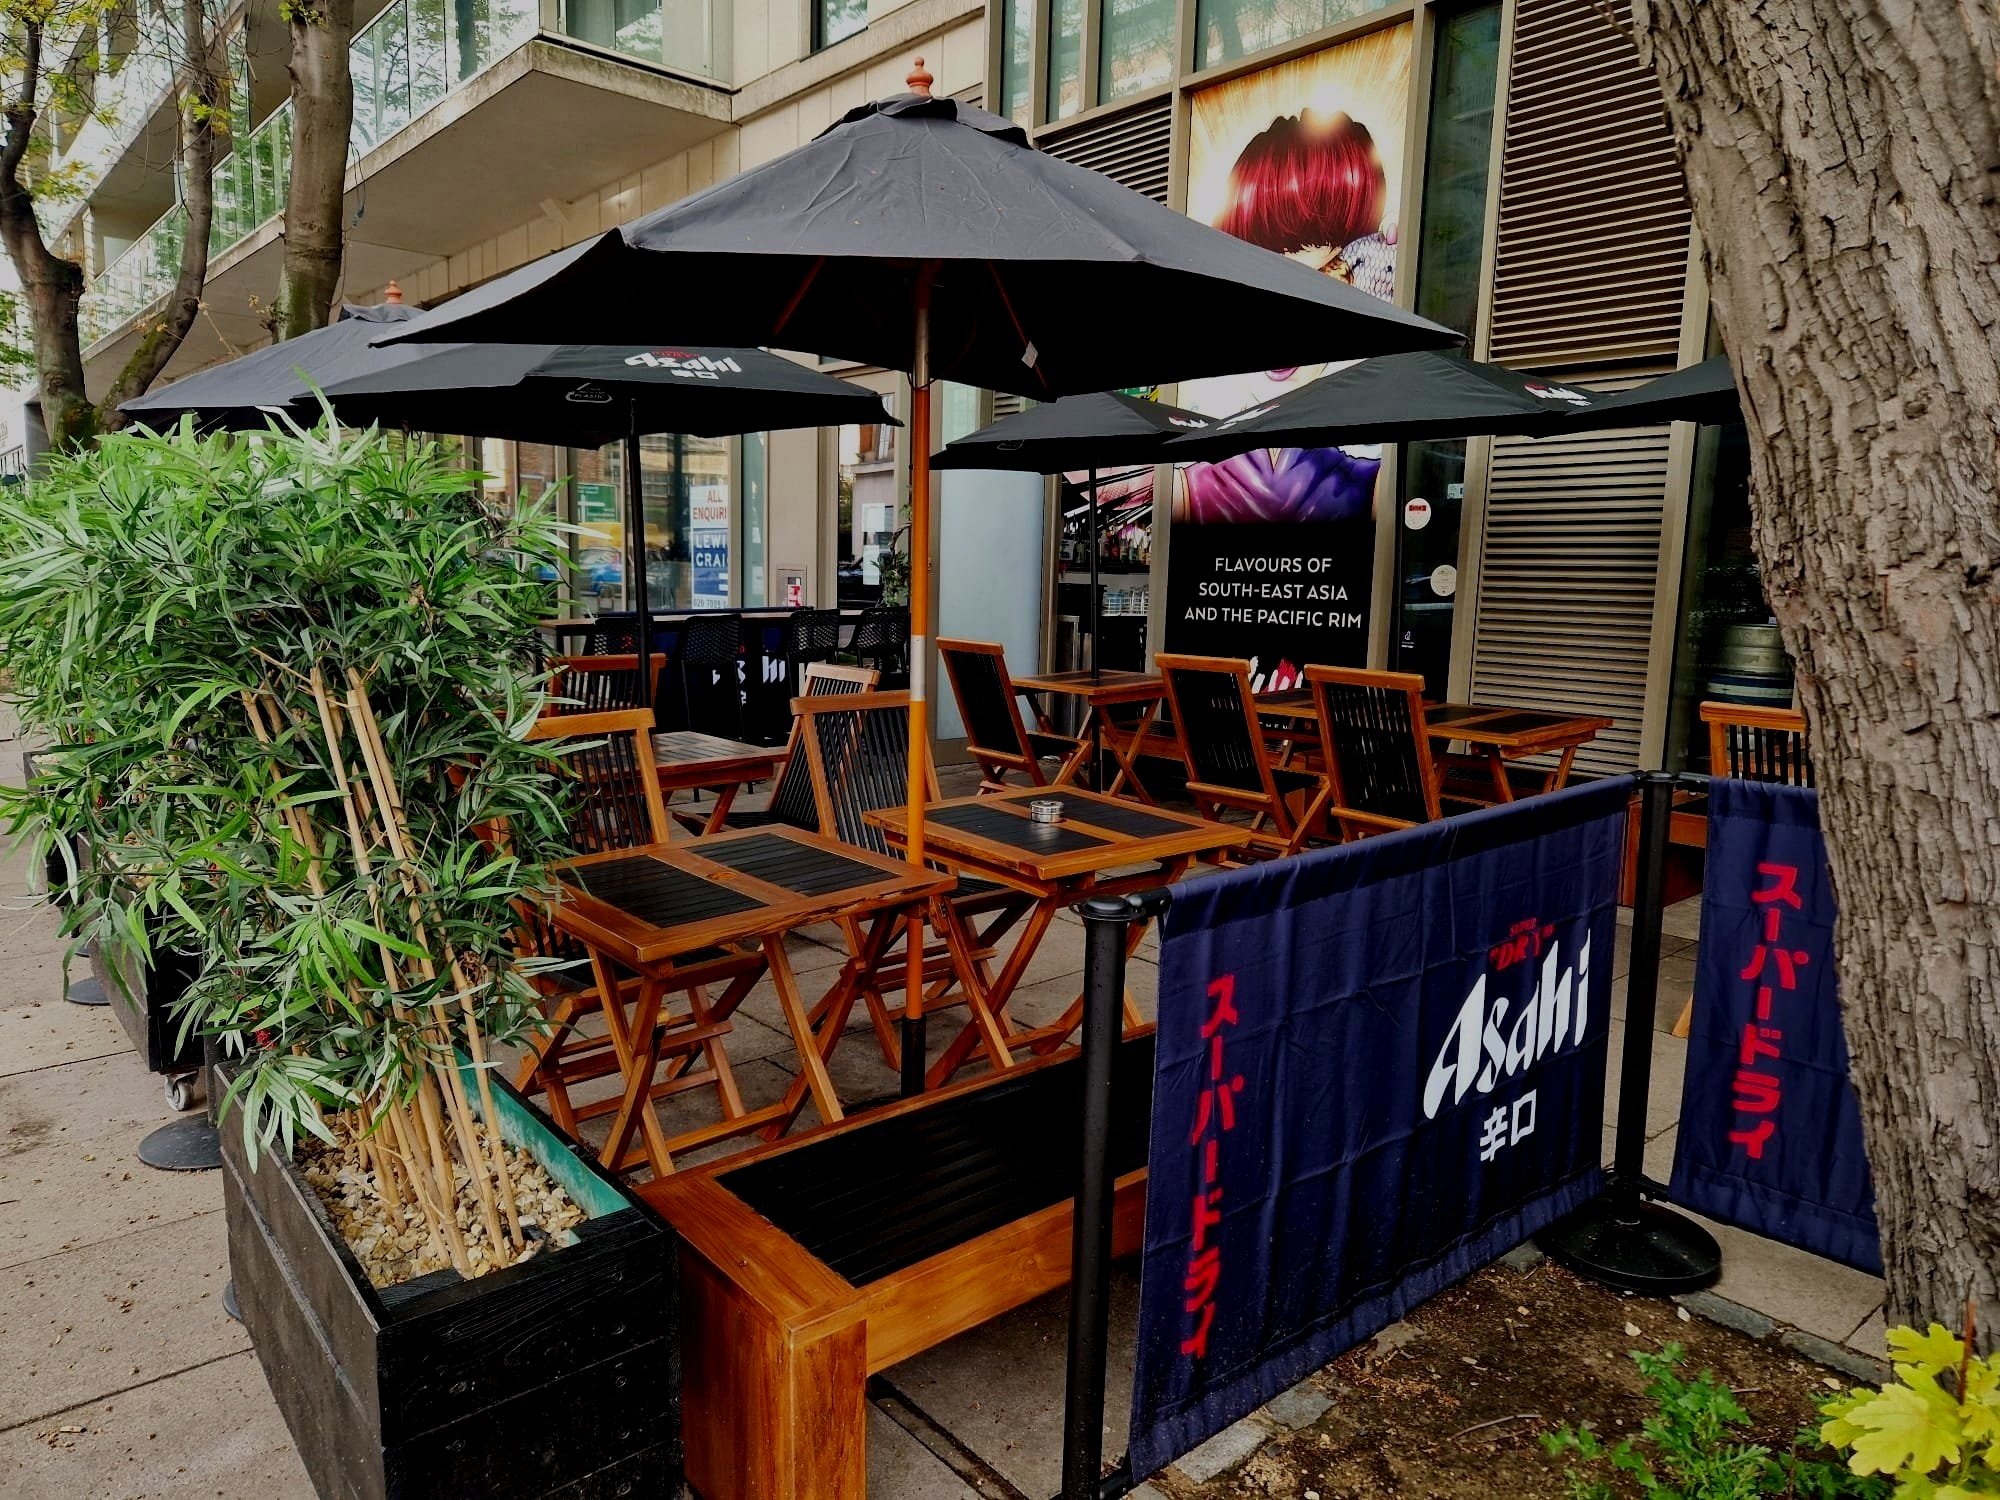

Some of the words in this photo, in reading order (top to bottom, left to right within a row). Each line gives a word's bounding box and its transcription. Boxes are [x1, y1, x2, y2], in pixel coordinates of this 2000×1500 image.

[624, 352, 742, 373] Asahi
[706, 490, 723, 502] ALL
[695, 534, 727, 549] LEWI
[695, 552, 729, 567] CRAI
[1215, 557, 1302, 573] FLAVOURS
[1307, 557, 1333, 573] OF
[1198, 582, 1304, 599] SOUTH-EAST
[1306, 585, 1349, 601] ASIA
[1184, 606, 1218, 621] AND
[1221, 607, 1253, 623] THE
[1257, 609, 1324, 627] PACIFIC
[1328, 612, 1362, 629] RIM
[1729, 863, 1809, 1159] スーパードライ
[1423, 928, 1591, 1120] Asahi
[1479, 1088, 1537, 1162] 辛口
[1181, 974, 1244, 1358] スーパードライ
